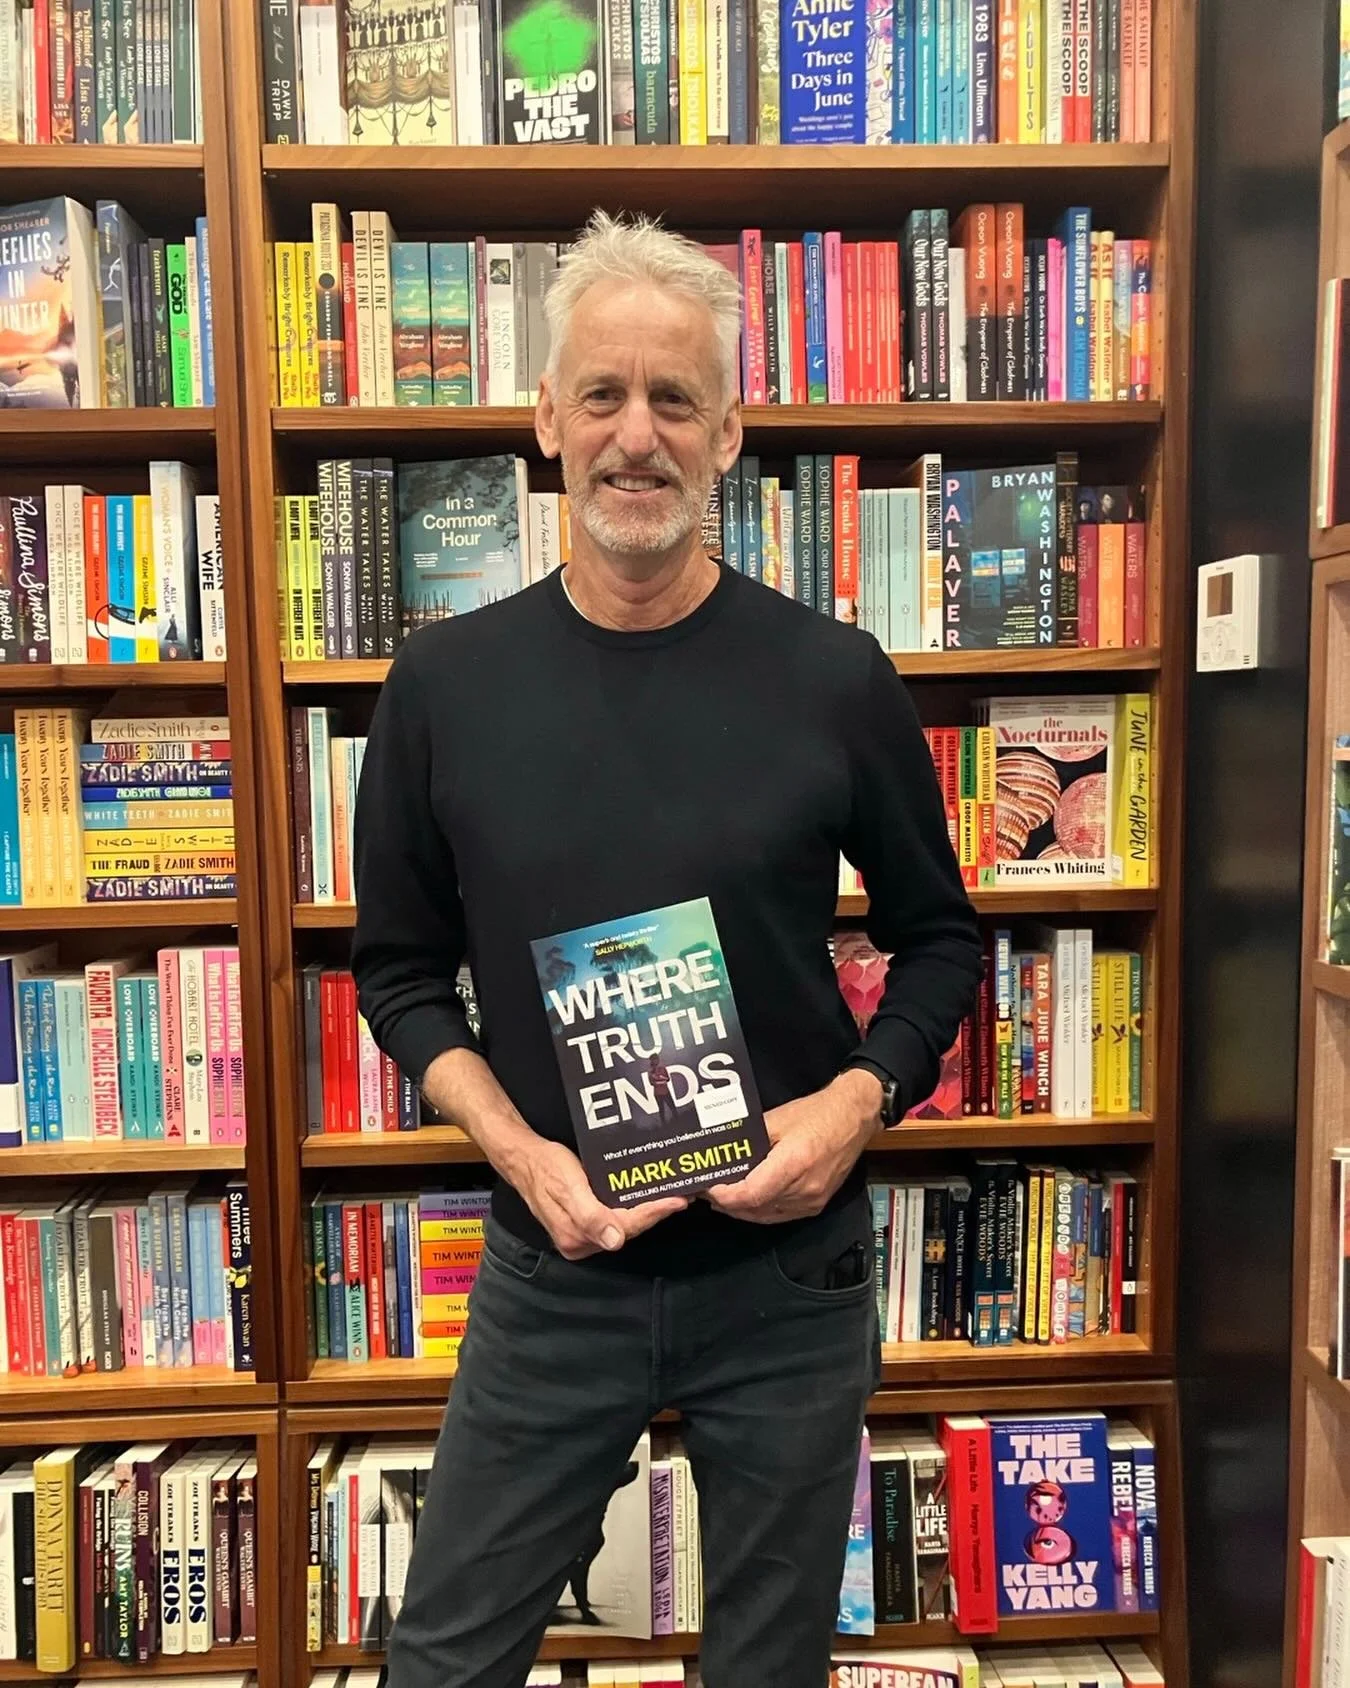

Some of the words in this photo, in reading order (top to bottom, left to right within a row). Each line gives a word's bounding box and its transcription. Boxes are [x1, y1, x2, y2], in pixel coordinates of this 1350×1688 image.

[791, 17, 854, 46] Tyler
[975, 4, 988, 43] 1983
[1079, 2, 1088, 31] THE
[802, 51, 853, 68] Three
[976, 52, 987, 75] Linn
[1079, 38, 1088, 94] SCOOP
[80, 79, 90, 102] Lisa
[504, 70, 597, 100] PEDRO
[791, 72, 832, 91] Days
[836, 69, 853, 85] in
[272, 79, 281, 121] TRIPP
[281, 80, 291, 121] DAWN
[523, 94, 578, 119] THE
[645, 71, 658, 133] barracuda
[814, 92, 853, 111] June
[976, 79, 987, 126] Ullmann
[81, 106, 92, 127] See
[513, 114, 588, 143] VAST
[1005, 211, 1015, 242] Ocean
[1074, 213, 1087, 230] THE
[0, 231, 52, 266] EFLIES
[373, 230, 386, 263] DEVIL
[933, 239, 947, 258] Our
[1003, 244, 1015, 279] Vuong
[1074, 232, 1087, 288] SUNFLOWER
[8, 268, 25, 299] IN
[374, 268, 386, 279] IS
[934, 260, 948, 280] New
[171, 273, 182, 315] GOD
[374, 286, 387, 311] FINE
[934, 281, 949, 306] Gods
[1006, 301, 1014, 316] The
[1074, 289, 1087, 312] BOYS
[938, 311, 946, 346] THOMAS
[1004, 317, 1014, 349] Emperor
[1003, 351, 1015, 360] of
[1006, 361, 1015, 393] Gladness
[380, 479, 388, 501] THE
[819, 464, 830, 506] SOPHIE
[840, 463, 853, 485] The
[926, 463, 941, 495] BRYAN
[991, 471, 1054, 489] BRYAN
[337, 462, 353, 556] WIFEHOUSE
[445, 497, 460, 511] In
[840, 488, 855, 534] Cicada
[9, 496, 38, 569] Paullina
[381, 507, 391, 546] WATER
[422, 511, 498, 530] Common
[820, 508, 831, 543] WARD
[926, 495, 941, 552] WASHINGTON
[441, 531, 482, 548] Hour
[202, 550, 214, 591] WIFE
[343, 560, 352, 590] SONYA
[382, 552, 391, 588] TAKES
[841, 538, 856, 580] House
[944, 479, 962, 648] PALAVER
[1036, 489, 1055, 643] WASHINGTON
[18, 570, 51, 642] Simons
[163, 577, 172, 613] SINCLAIR
[344, 591, 353, 628] WALGER
[99, 721, 146, 740] Zadie
[147, 720, 191, 739] Smith
[996, 725, 1108, 743] Nocturnals
[1043, 717, 1063, 729] the
[1129, 710, 1149, 752] JUNE
[85, 761, 140, 782] ZADIE
[142, 760, 199, 781] SMITH
[1136, 772, 1147, 793] the
[84, 809, 119, 821] WHITE
[121, 808, 156, 820] TEETH
[167, 808, 203, 819] ZADIE
[1128, 794, 1149, 862] GARDEN
[964, 827, 972, 863] MANIFESTO
[91, 860, 112, 870] THE
[115, 859, 151, 870] FRAUD
[164, 858, 197, 869] ZADIE
[198, 857, 235, 869] SMITH
[996, 862, 1052, 876] Frances
[1053, 861, 1106, 877] Whiting
[88, 970, 113, 1020] FAVORITA
[547, 948, 720, 1026] WHERE
[1037, 962, 1049, 1000] TARA
[125, 1009, 135, 1062] OVERBOARD
[566, 1000, 727, 1075] TRUTH
[1037, 1006, 1050, 1044] JUNE
[91, 1027, 117, 1079] MICHELLE
[1037, 1049, 1049, 1097] WINCH
[164, 1078, 174, 1121] STEPHENS
[172, 1086, 181, 1113] CLARE
[579, 1052, 741, 1130] ENDS
[94, 1080, 119, 1137] STEINBECK
[602, 1150, 622, 1161] What
[627, 1139, 665, 1156] everything
[663, 1135, 677, 1149] you
[675, 1129, 705, 1143] believed
[710, 1124, 726, 1134] was
[607, 1158, 674, 1192] MARK
[677, 1138, 753, 1174] SMITH
[619, 1185, 660, 1202] BESTSELLING
[658, 1179, 685, 1193] AUTHOR
[684, 1177, 694, 1187] OF
[693, 1172, 714, 1184] THREE
[713, 1168, 732, 1180] BOYS
[730, 1163, 750, 1176] GONE
[230, 1192, 244, 1259] Summers
[346, 1211, 358, 1222] IN
[442, 1227, 458, 1235] TIM
[460, 1226, 486, 1235] WINT
[347, 1222, 360, 1273] MEMORIAM
[241, 1294, 250, 1322] Karen
[350, 1295, 362, 1319] ALICE
[242, 1324, 251, 1347] Swan
[351, 1319, 363, 1344] WINN
[1009, 1433, 1081, 1459] THE
[884, 1467, 897, 1487] To
[997, 1458, 1096, 1486] TAKE
[925, 1493, 936, 1504] A
[1111, 1461, 1133, 1517] REBEL
[46, 1480, 65, 1546] DONNA
[137, 1490, 149, 1536] COLLISION
[884, 1489, 900, 1542] Paradise
[915, 1505, 947, 1518] LITTLE
[915, 1517, 949, 1537] LIFE
[652, 1473, 671, 1586] MISINTERPRETATION
[219, 1531, 231, 1569] QUEEN'S
[47, 1550, 66, 1614] TARTT
[119, 1575, 128, 1598] AMY
[187, 1548, 207, 1624] EROS
[221, 1569, 231, 1608] GAMBIT
[1001, 1561, 1099, 1587] KELLY
[1005, 1583, 1098, 1610] YANG
[119, 1600, 129, 1639] TAYLOR
[836, 1665, 953, 1688] SUPERFAN
